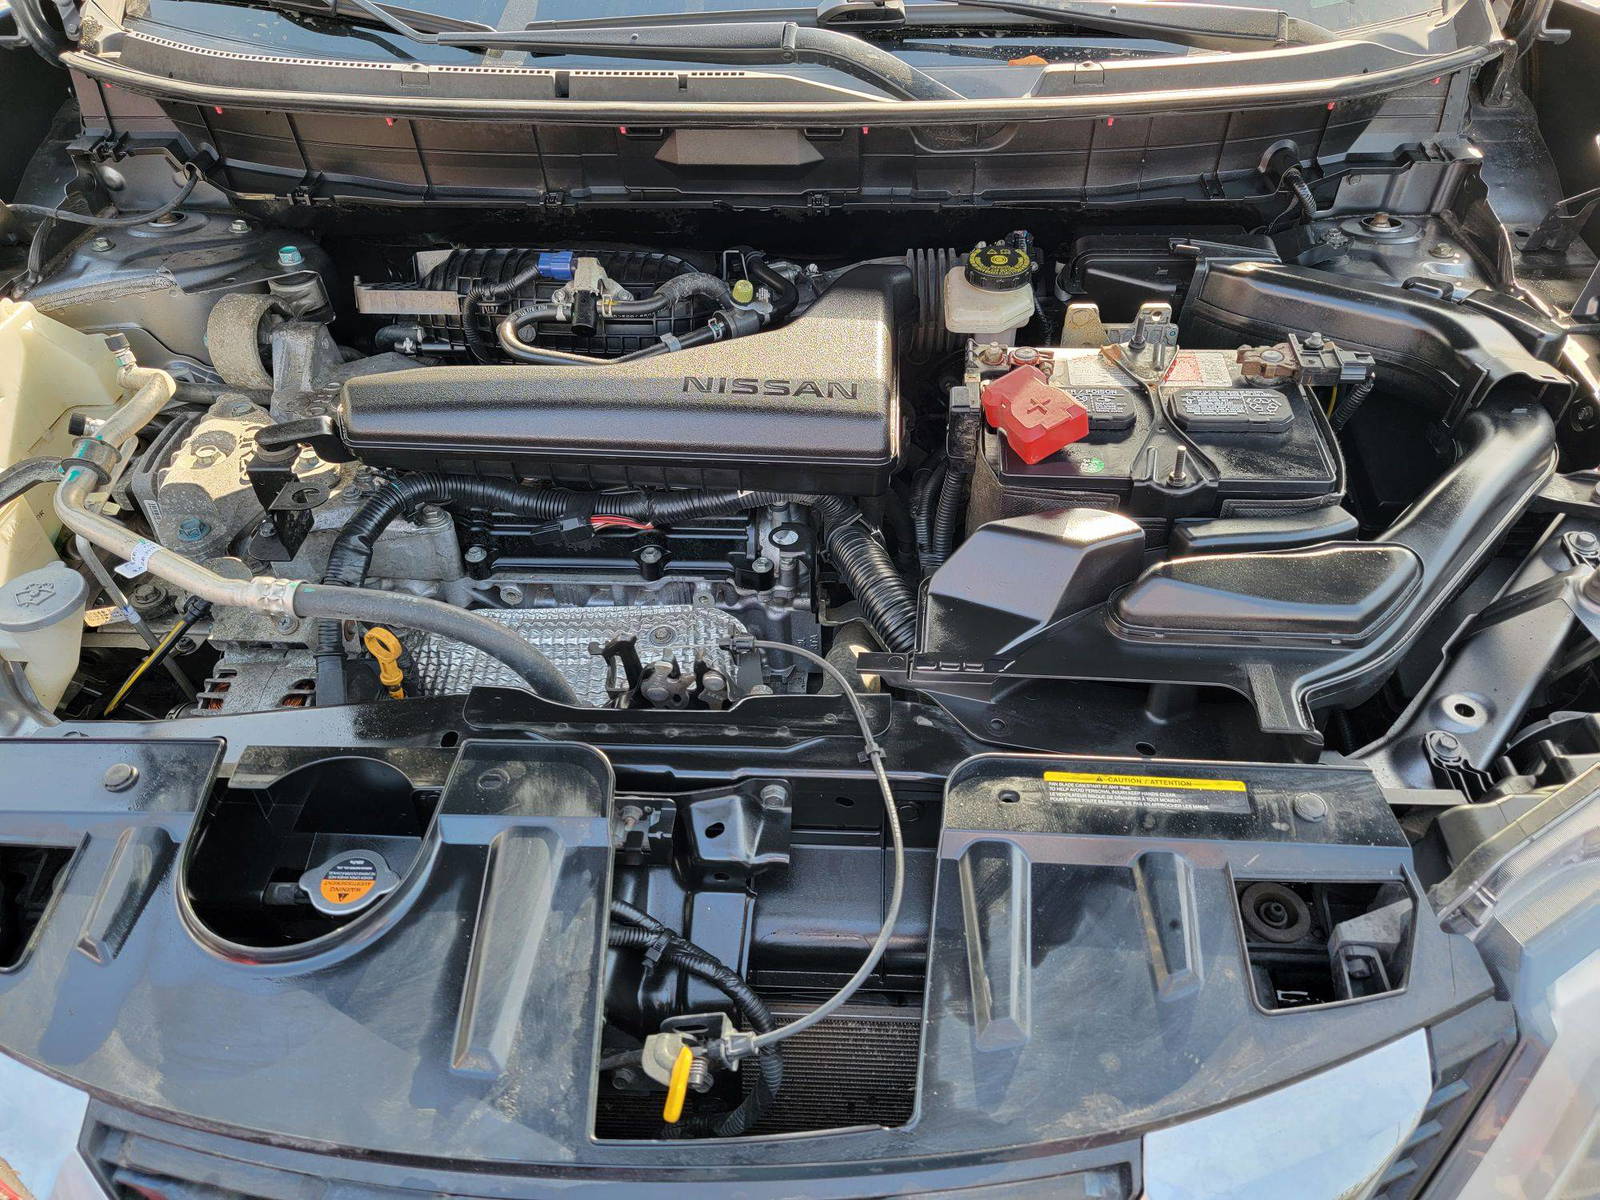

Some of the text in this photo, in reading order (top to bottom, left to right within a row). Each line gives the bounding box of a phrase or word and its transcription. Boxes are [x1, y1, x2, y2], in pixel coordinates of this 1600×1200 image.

[682, 376, 858, 400] NISSAN
[1107, 777, 1142, 785] CAUTION
[1150, 779, 1193, 787] ATTENTION
